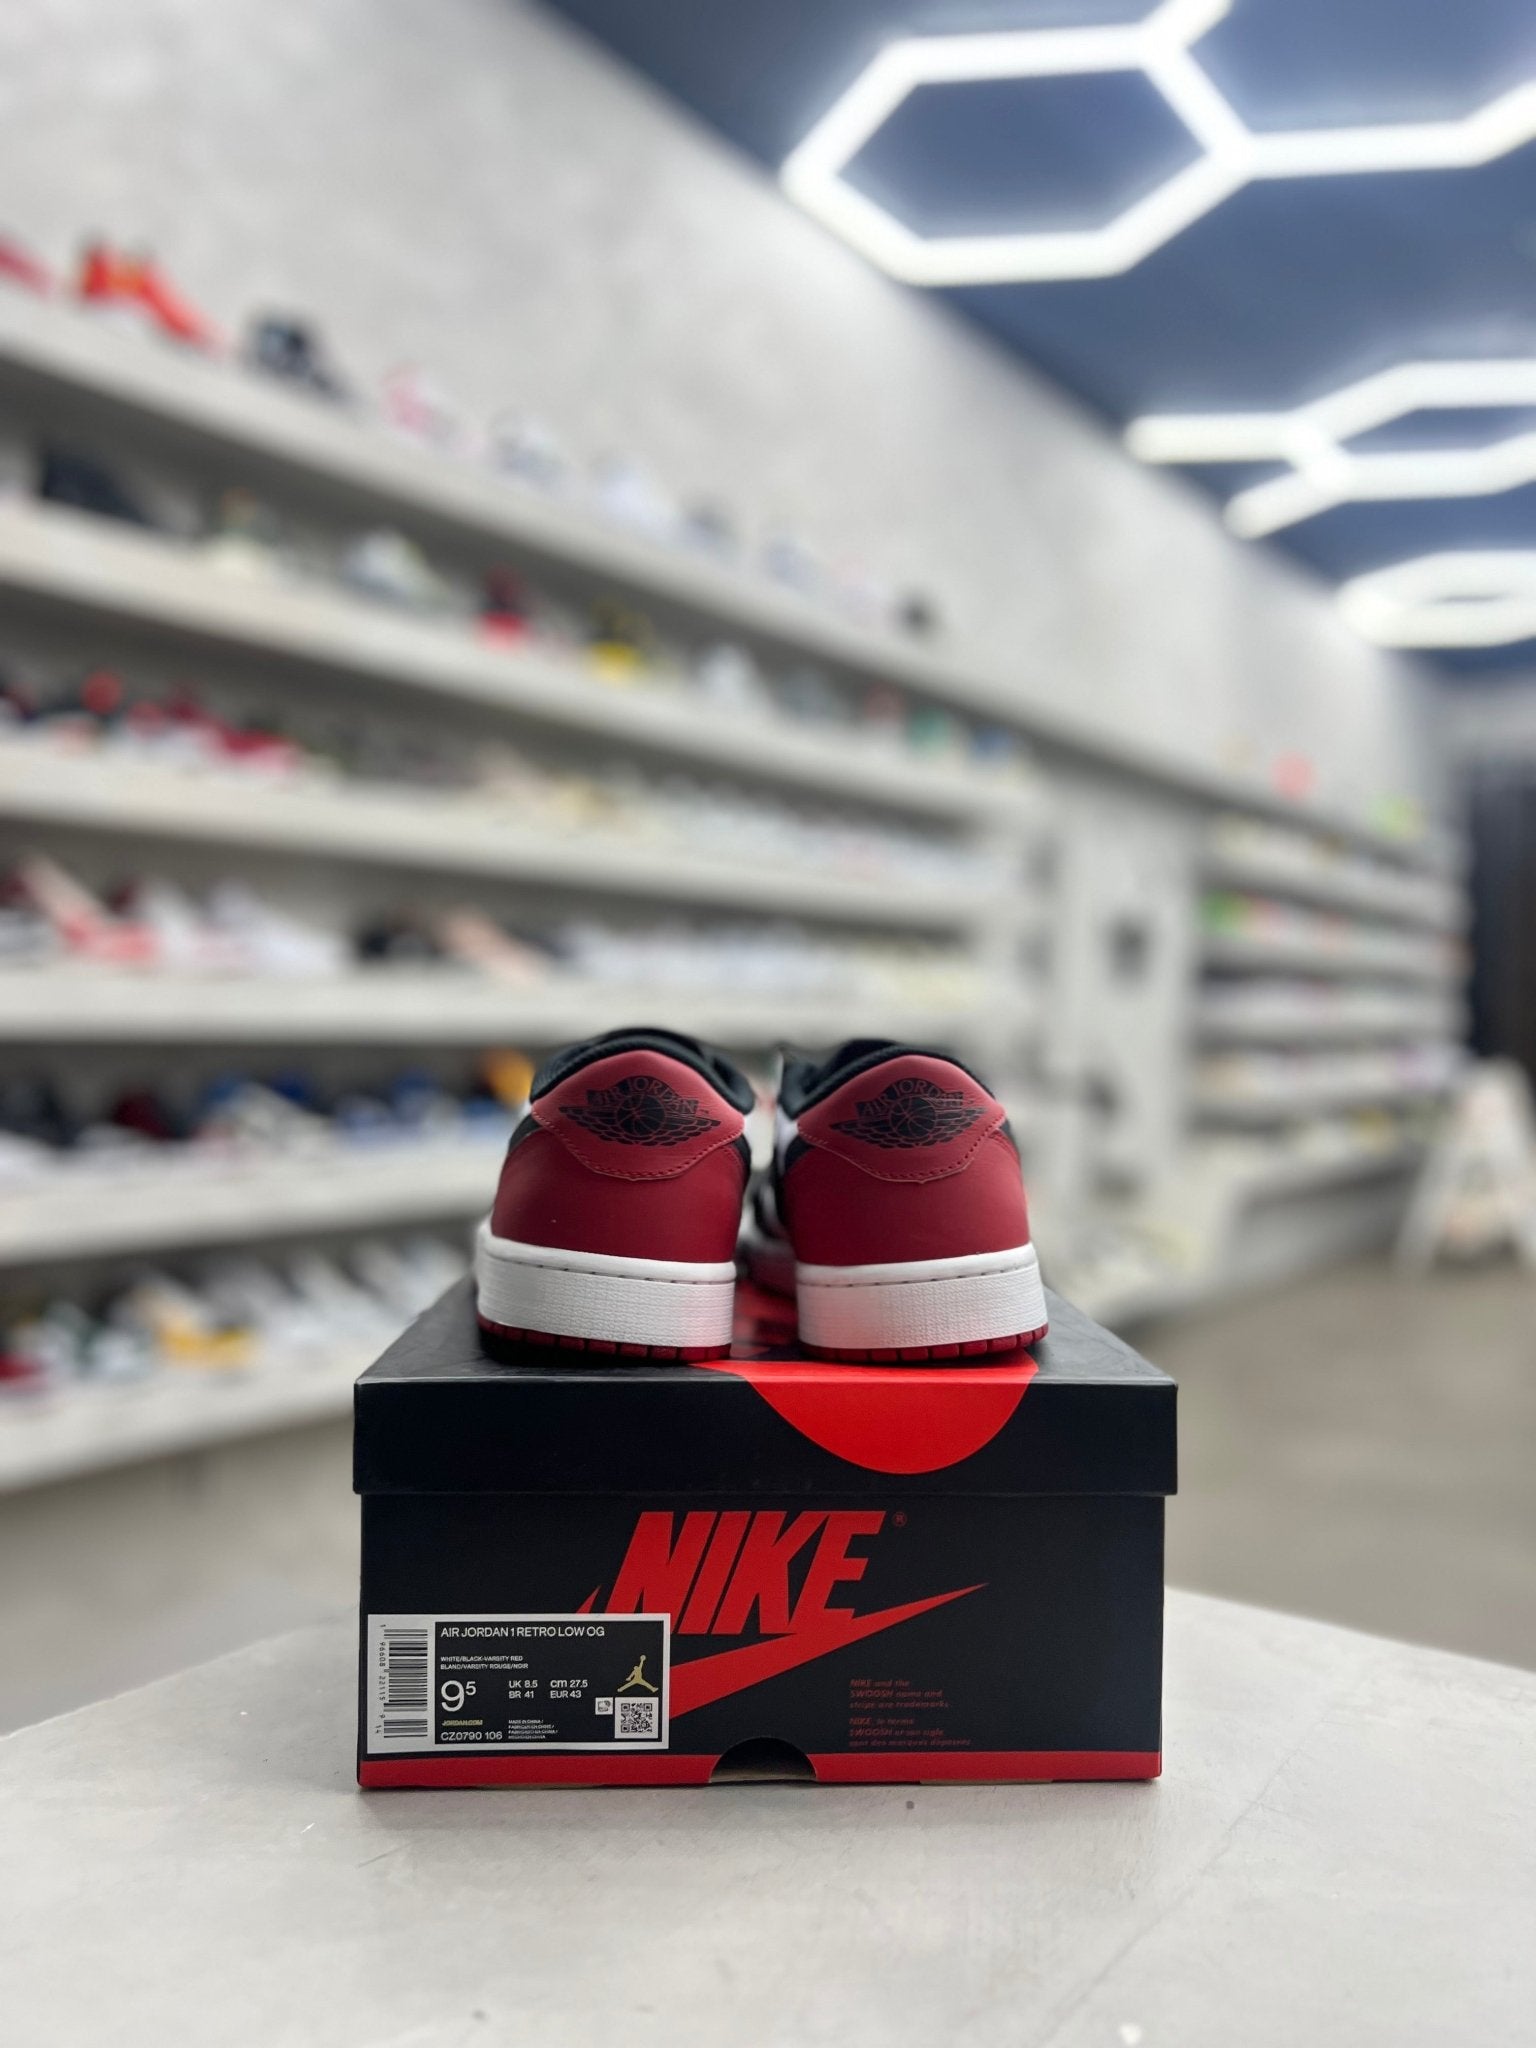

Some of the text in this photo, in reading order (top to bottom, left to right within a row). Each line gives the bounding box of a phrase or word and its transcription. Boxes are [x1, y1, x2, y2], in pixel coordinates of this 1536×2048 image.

[605, 1510, 886, 1635] NIKE
[440, 1626, 605, 1637] AIR JORDAN 1 RETRO LOW OG
[508, 1680, 538, 1688] UK 8.5
[569, 1680, 588, 1688] 27.5
[508, 1690, 535, 1699] BR 41
[550, 1690, 582, 1698] EUR 43
[850, 1690, 894, 1698] SWOOSH
[440, 1731, 483, 1741] CZ0790
[485, 1730, 503, 1740] 106
